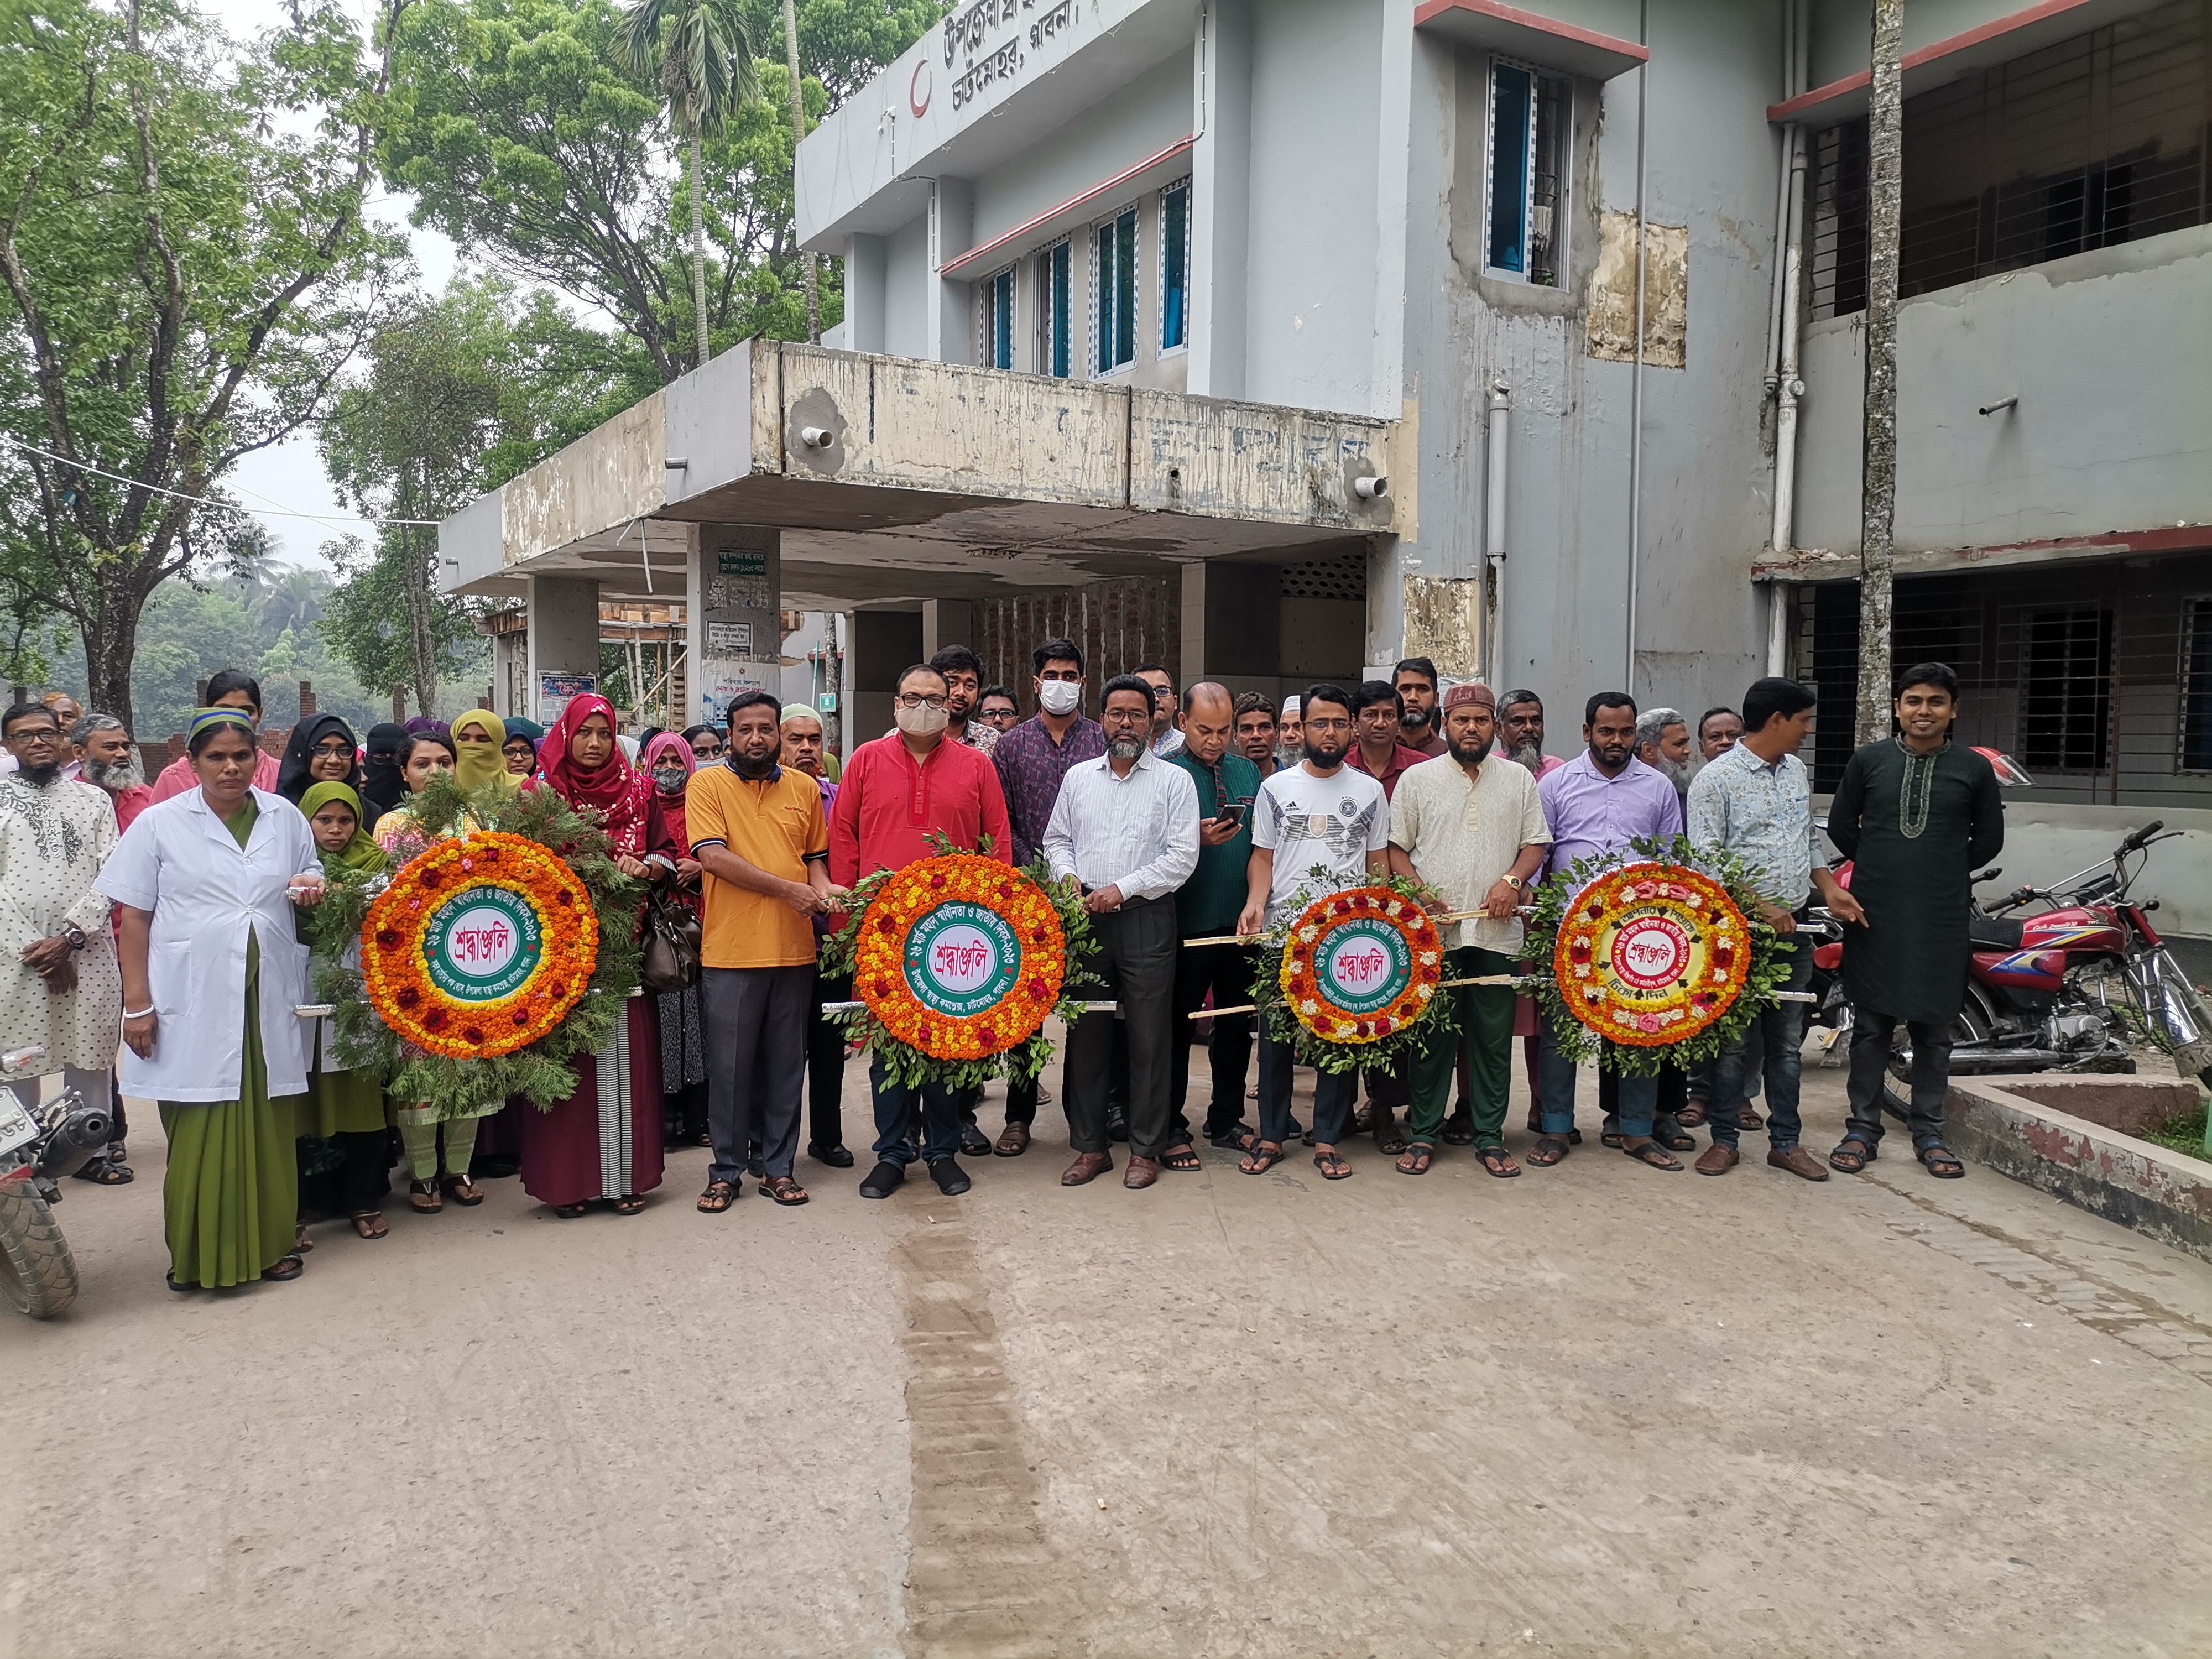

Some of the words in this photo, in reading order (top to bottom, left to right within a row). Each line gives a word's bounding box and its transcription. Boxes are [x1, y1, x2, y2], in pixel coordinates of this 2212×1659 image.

[436, 901, 458, 920] মহান
[486, 889, 492, 899] ও
[935, 904, 966, 921] স্বাধীনতা
[968, 907, 974, 917] ও
[1620, 906, 1656, 922] আপনার
[919, 915, 940, 932] মহান
[975, 907, 998, 928] জাতীয়
[455, 920, 509, 964] শ্রদ্ধাঞ্জলি
[912, 927, 926, 945] মার্চ
[1322, 930, 1340, 946] মহান
[1364, 920, 1370, 928] ও
[910, 946, 923, 957] ২৬
[935, 940, 988, 981] শ্রদ্ধাঞ্জলি
[1628, 941, 1671, 968] শ্রদ্ধাঞ্জলি
[1337, 947, 1384, 984] শ্রদ্ধাঞ্জলি
[911, 968, 928, 994] উপজেলা
[1608, 978, 1634, 998] টিকা
[1646, 989, 1668, 1000] দিন
